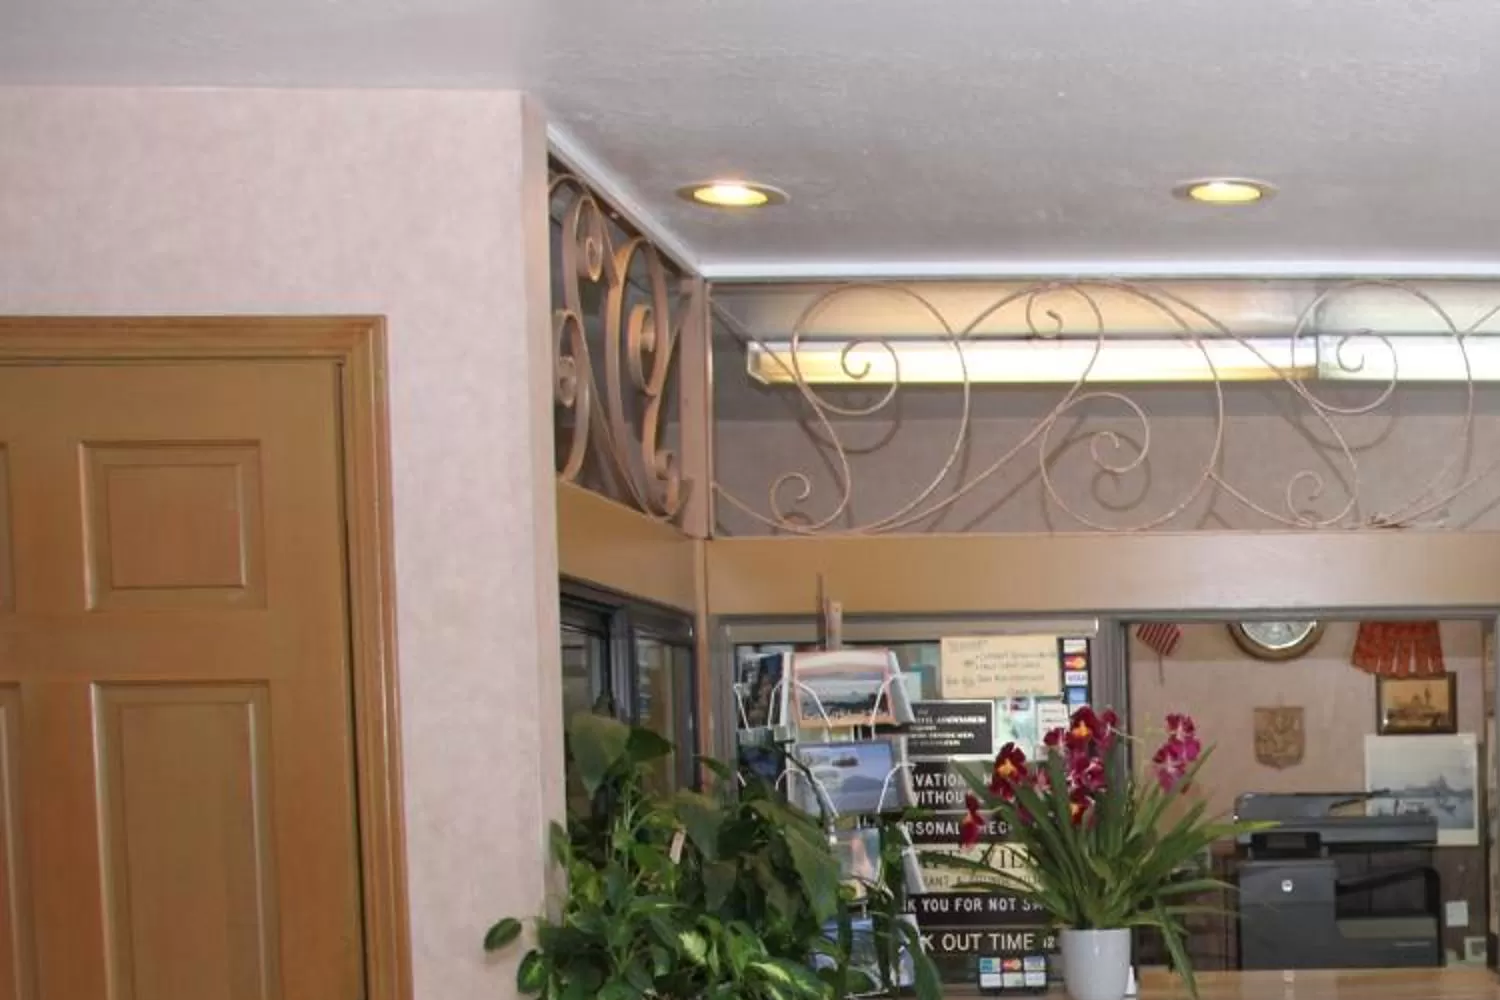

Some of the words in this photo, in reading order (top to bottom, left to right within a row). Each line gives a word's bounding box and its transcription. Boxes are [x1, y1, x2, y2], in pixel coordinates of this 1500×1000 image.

[920, 897, 949, 912] YOU
[953, 897, 983, 911] FOR
[988, 897, 1017, 911] NOT
[941, 933, 983, 951] OUT
[988, 932, 1035, 950] TIME
